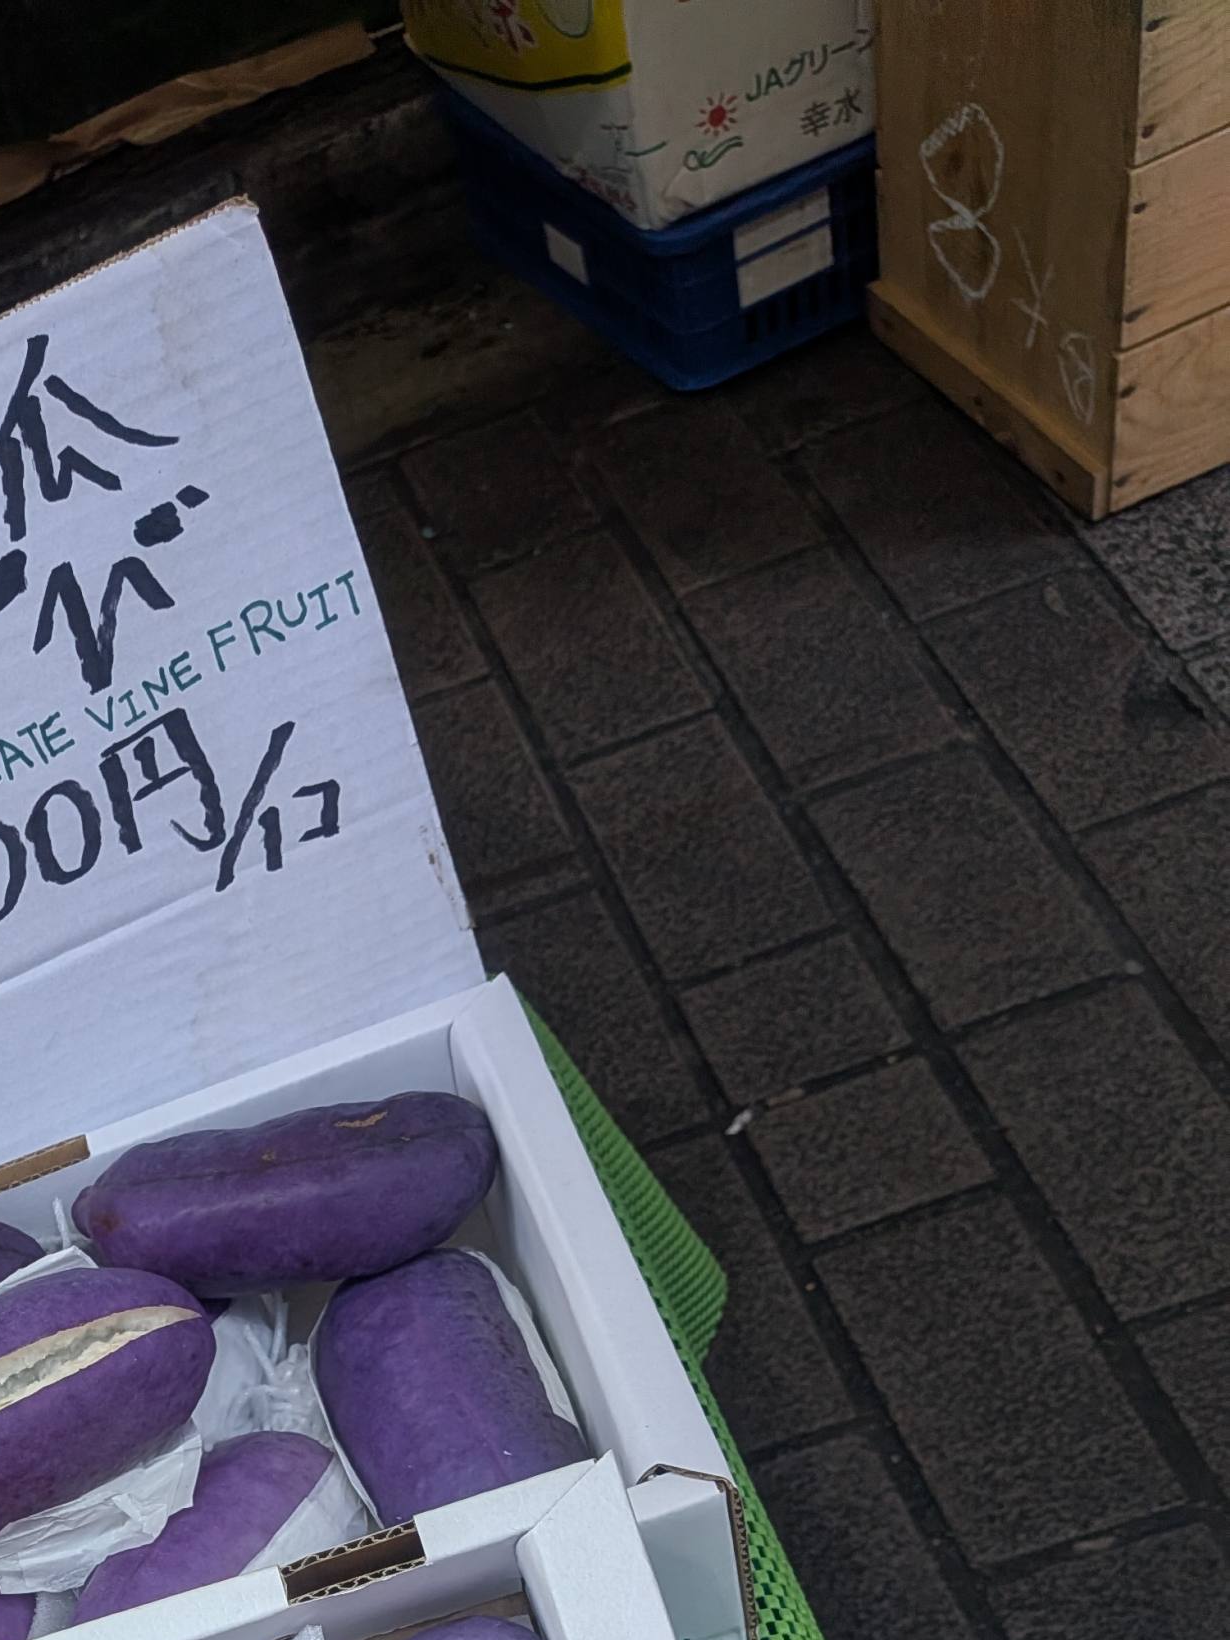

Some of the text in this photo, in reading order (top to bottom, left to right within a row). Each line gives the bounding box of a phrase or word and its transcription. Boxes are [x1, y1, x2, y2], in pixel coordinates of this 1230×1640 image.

[800, 86, 864, 137] 幸水
[84, 650, 203, 733] VINE
[206, 569, 362, 672] FRUIT
